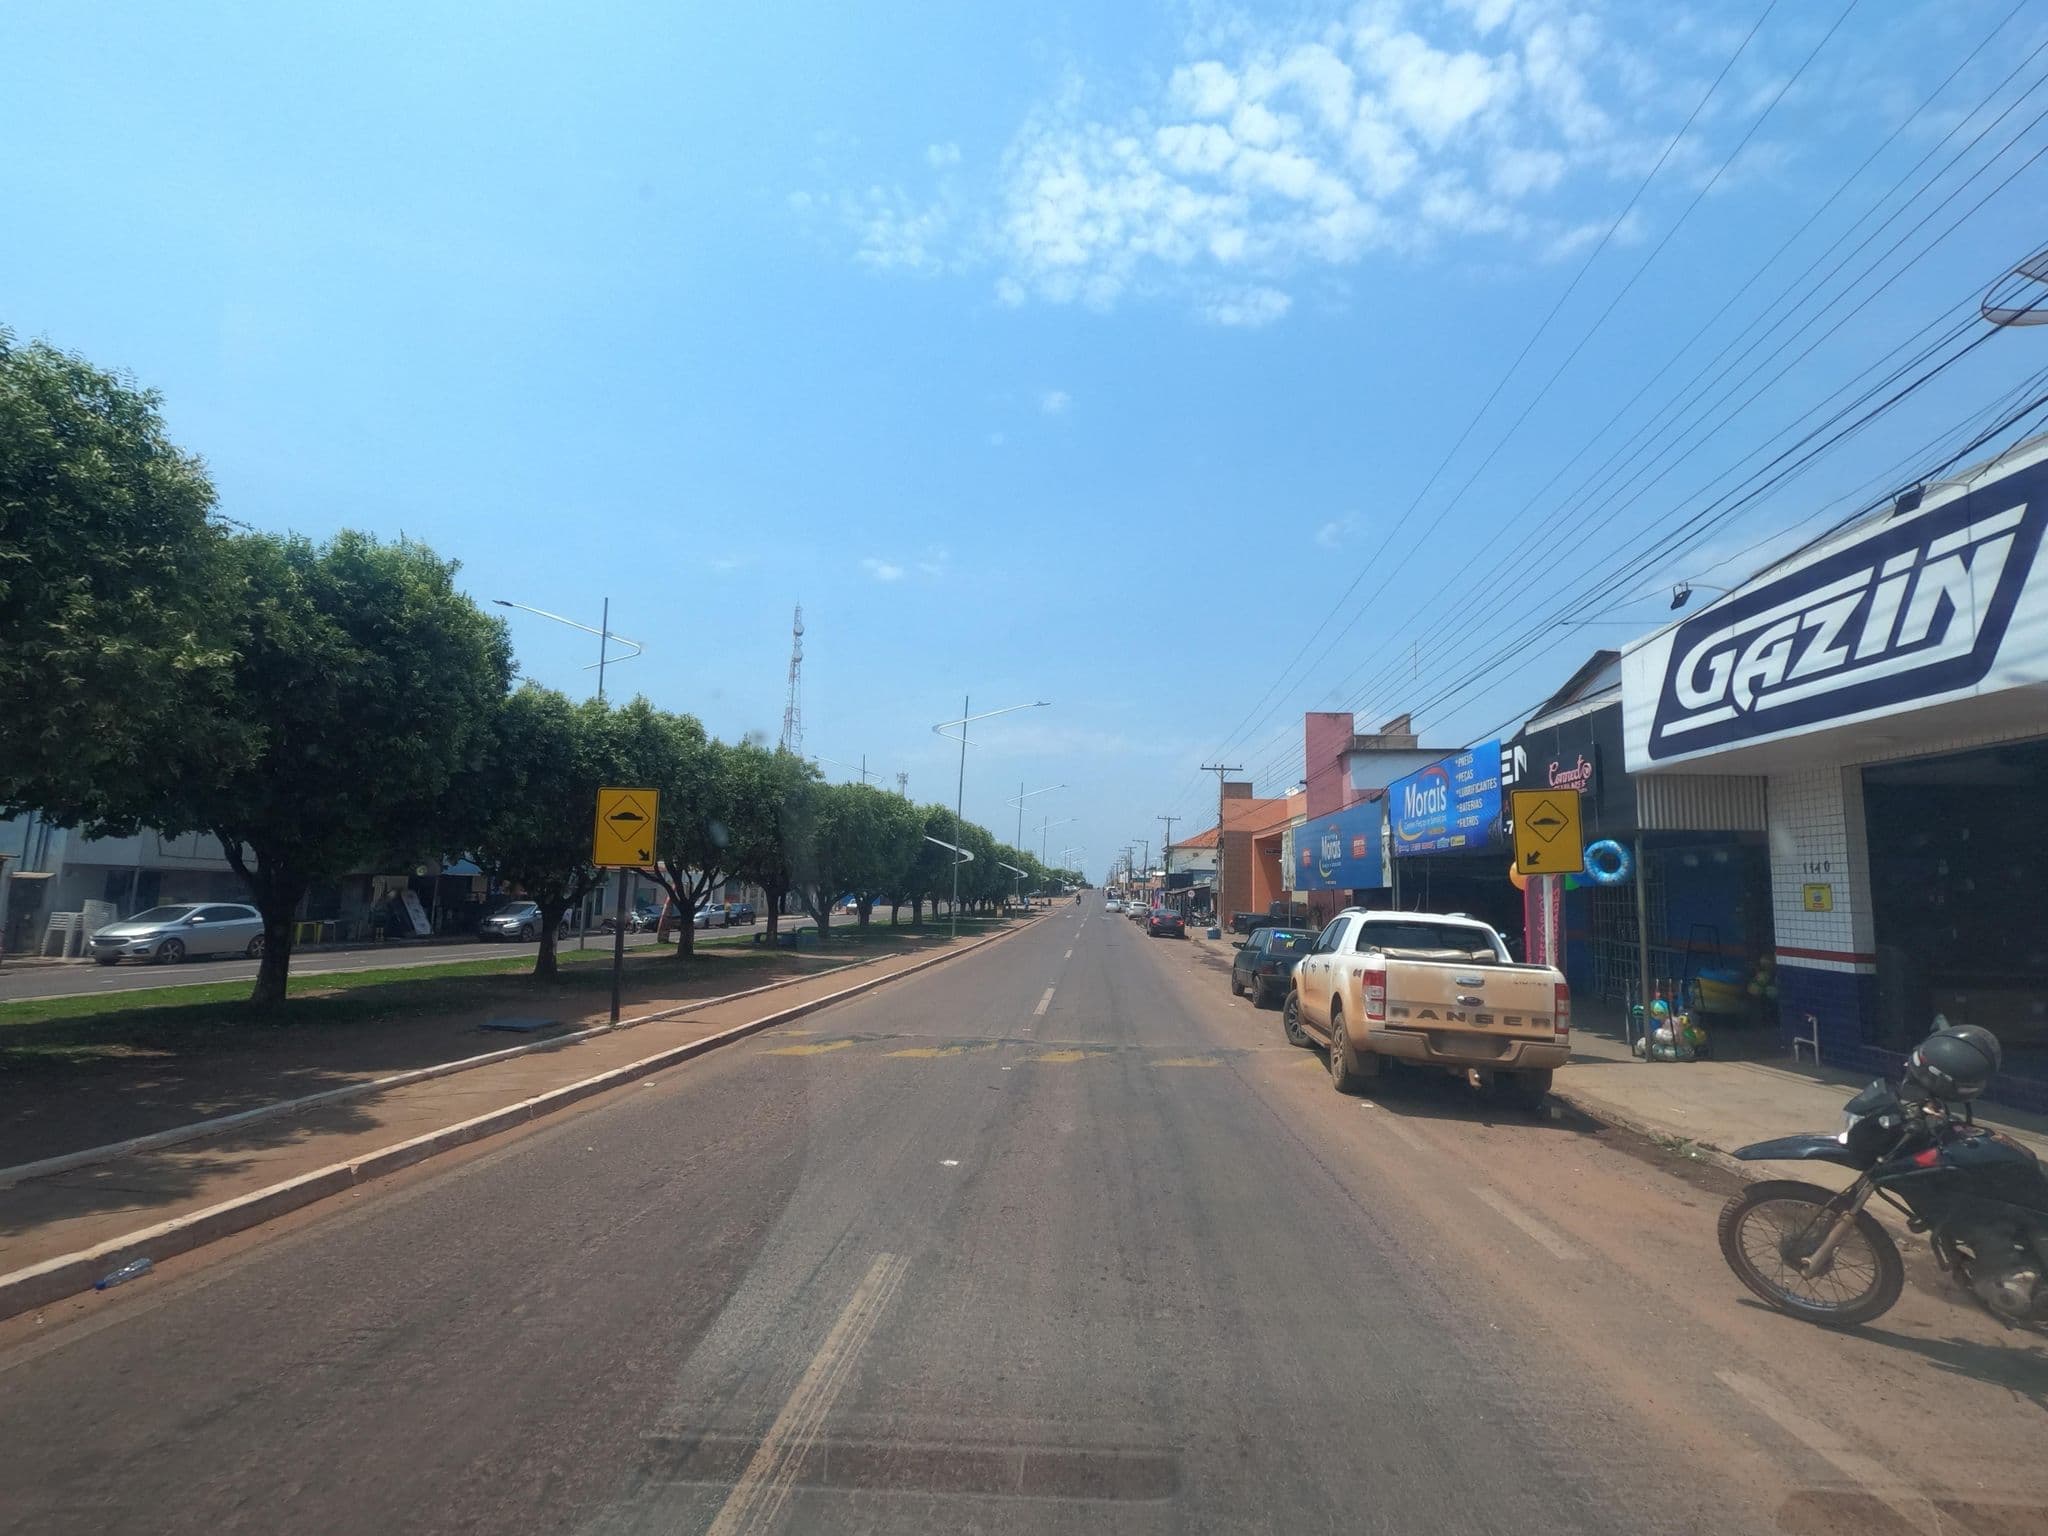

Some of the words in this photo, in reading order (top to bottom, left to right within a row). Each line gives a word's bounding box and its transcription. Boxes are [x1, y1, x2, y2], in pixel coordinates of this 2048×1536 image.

[1676, 503, 2028, 712] GAZIN
[1405, 778, 1447, 819] Morais
[1458, 778, 1498, 798] LUBRIFICANTES
[1458, 798, 1483, 812] BATERIAS
